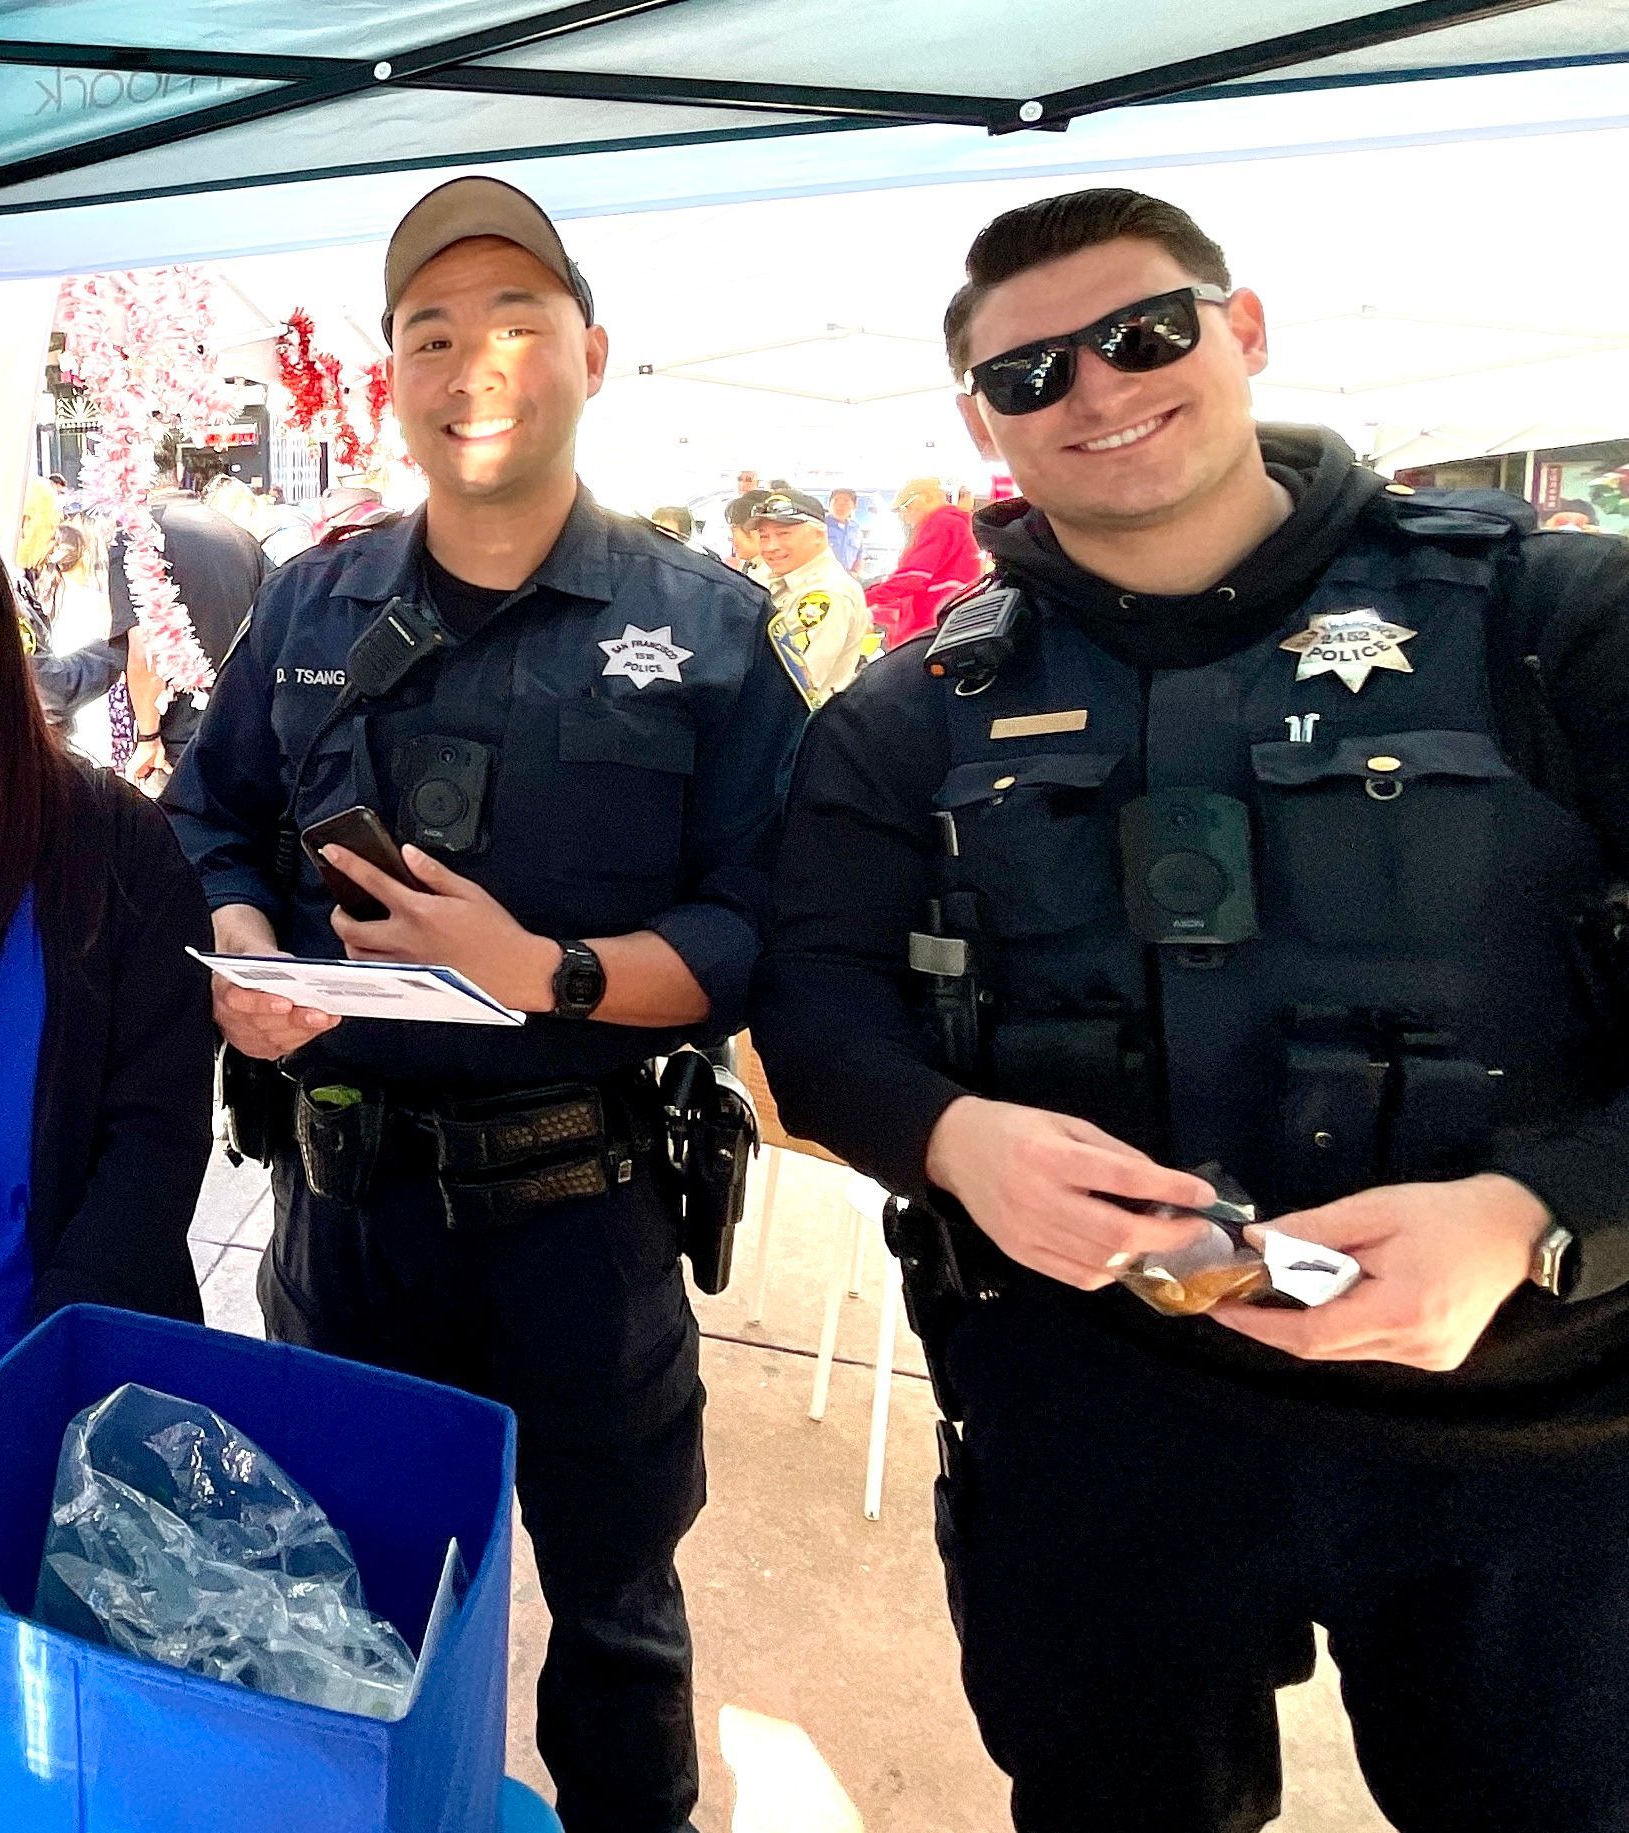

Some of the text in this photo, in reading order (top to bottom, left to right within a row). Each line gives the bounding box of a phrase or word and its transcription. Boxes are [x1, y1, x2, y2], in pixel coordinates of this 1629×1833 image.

[1307, 640, 1392, 662] POLICE
[276, 667, 346, 686] D. TSANG
[623, 661, 664, 673] POLICE
